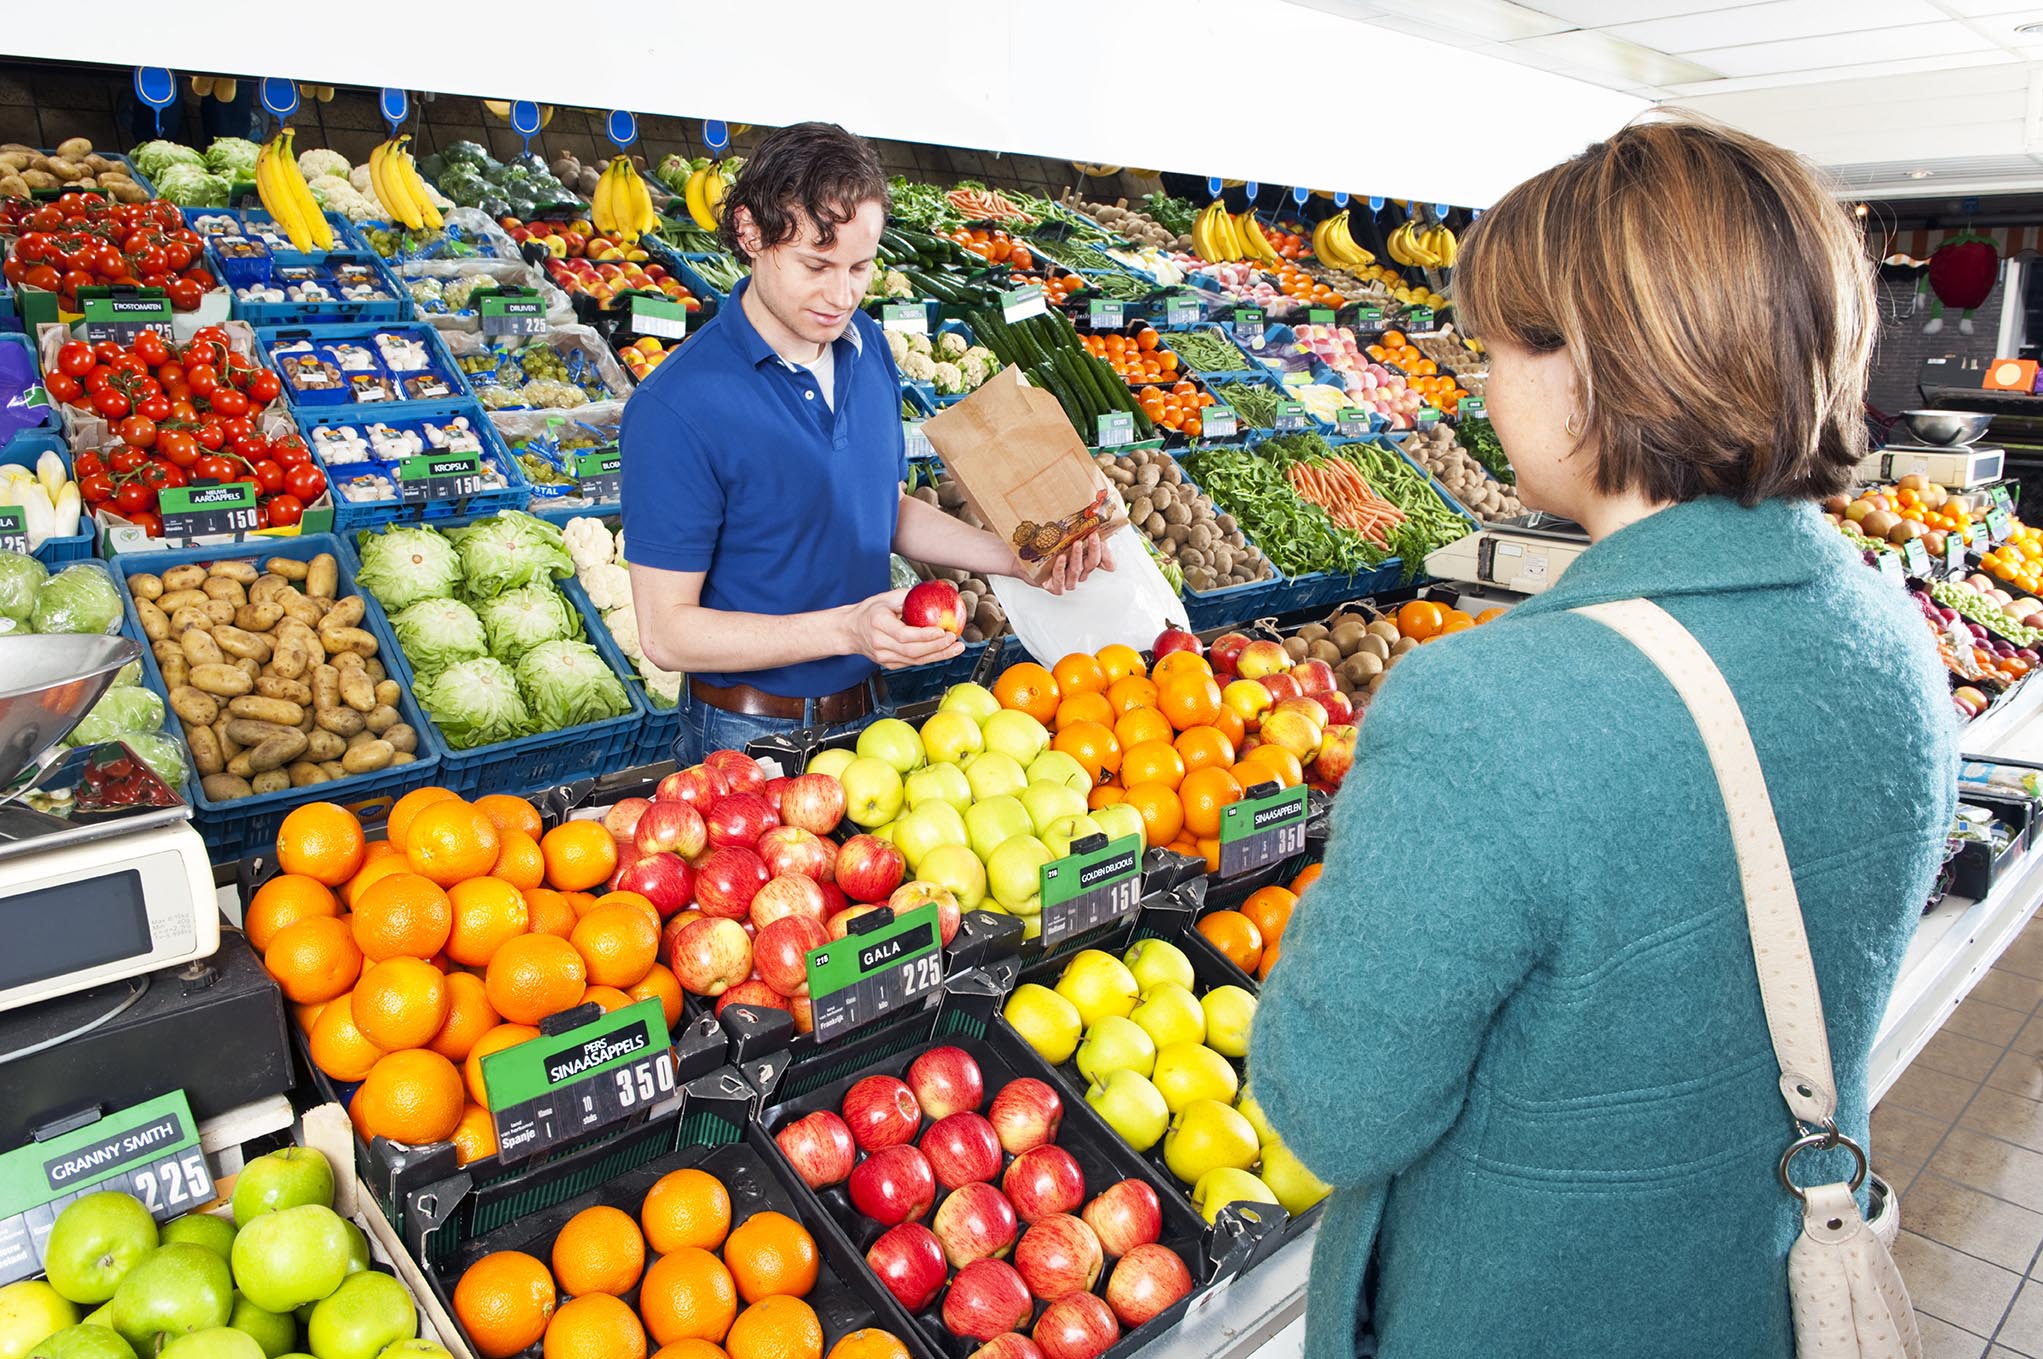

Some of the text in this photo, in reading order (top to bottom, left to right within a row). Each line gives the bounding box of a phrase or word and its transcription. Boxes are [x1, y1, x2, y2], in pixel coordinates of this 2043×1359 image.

[113, 303, 162, 311] TROSTOMATEN
[526, 318, 546, 332] 225
[434, 462, 469, 473] KROPSLA
[455, 475, 481, 495] 150
[194, 492, 241, 503] AARDAPPELS
[0, 518, 14, 527] LA
[227, 508, 258, 530] 150
[0, 535, 26, 555] 25
[1254, 802, 1302, 825] SINAASAPPELEN
[1278, 823, 1305, 854] 350
[1081, 856, 1134, 883] GOLDEN DELICIOUS
[1110, 877, 1140, 914] 150
[815, 954, 829, 966] 215
[863, 941, 901, 966] GALA
[903, 953, 941, 997] 225
[583, 1037, 608, 1055] PERS
[550, 1034, 645, 1083] SINAASAPPELS
[615, 1054, 675, 1107] 350
[582, 1095, 593, 1113] 10
[502, 1129, 536, 1149] Spanje
[51, 1122, 174, 1180] GRANNY SMITH
[135, 1154, 211, 1213] 225
